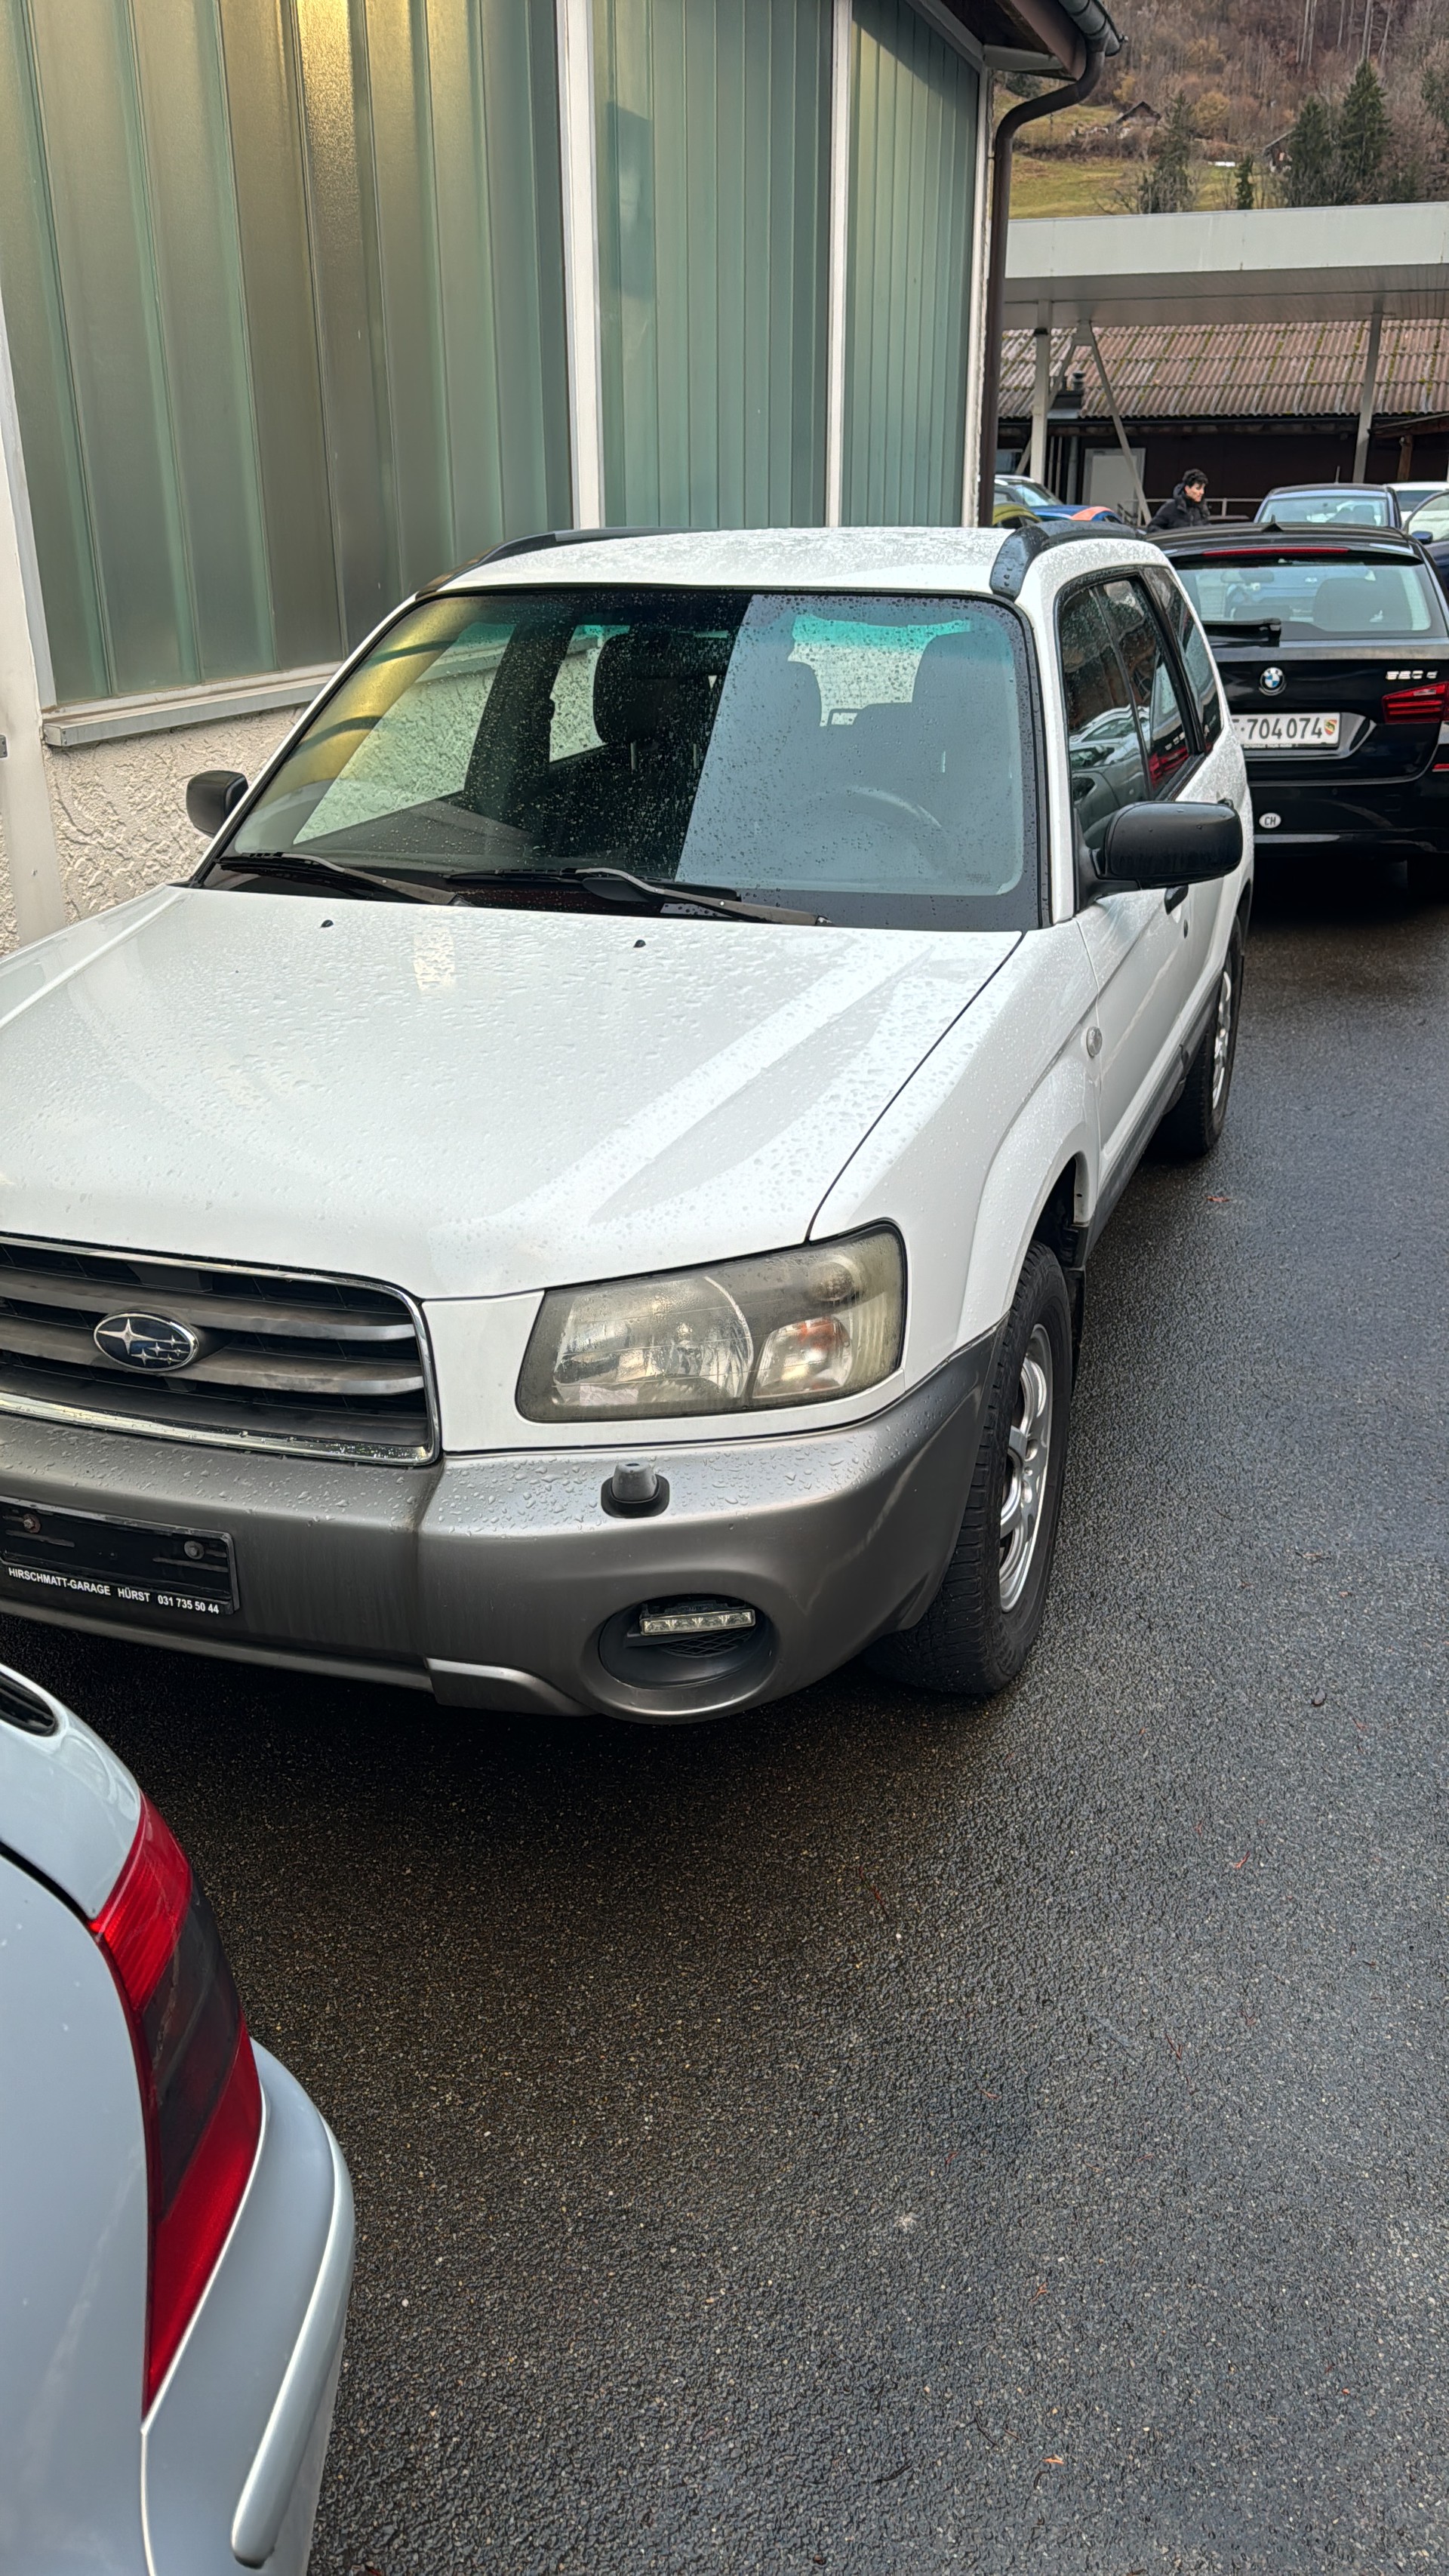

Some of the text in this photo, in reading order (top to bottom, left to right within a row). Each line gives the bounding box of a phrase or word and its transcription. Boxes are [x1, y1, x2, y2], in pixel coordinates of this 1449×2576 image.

[1264, 816, 1277, 826] CH
[8, 1567, 220, 1614] HIRSCHMATT-GARAGE HÜRST 031 735 50 44
